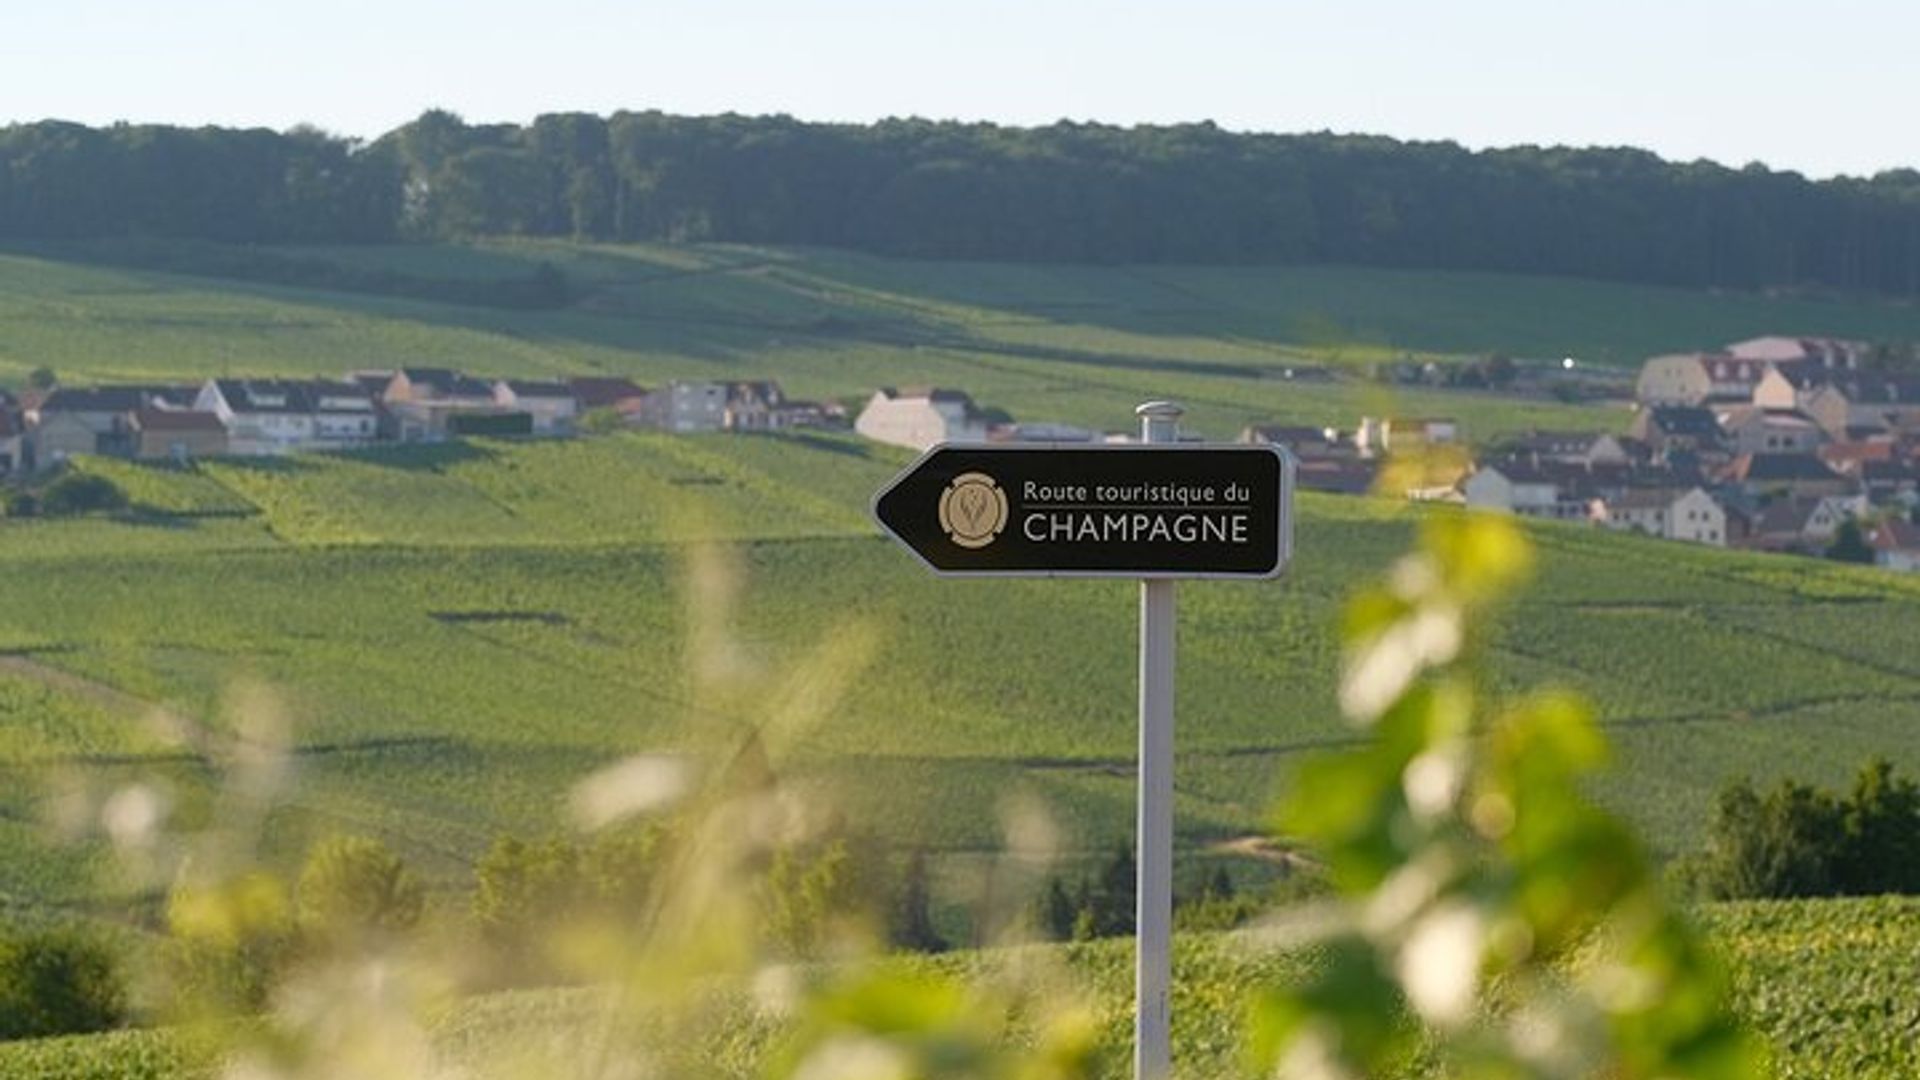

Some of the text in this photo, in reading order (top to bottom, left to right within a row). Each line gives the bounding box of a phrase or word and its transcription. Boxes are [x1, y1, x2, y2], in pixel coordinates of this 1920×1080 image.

[1023, 481, 1250, 506] Route touristique du
[1023, 513, 1249, 542] CHAMPAGNE
